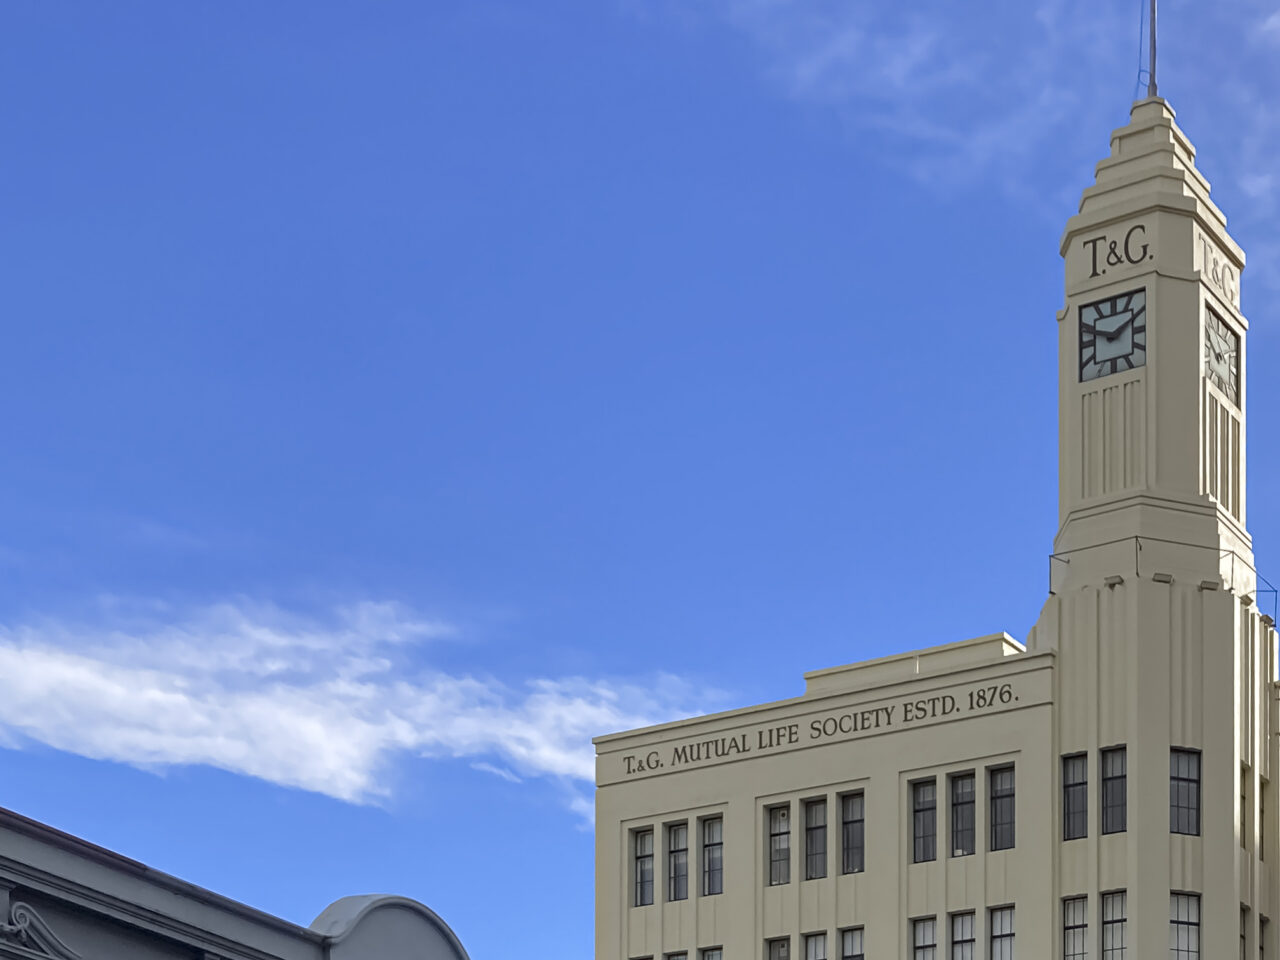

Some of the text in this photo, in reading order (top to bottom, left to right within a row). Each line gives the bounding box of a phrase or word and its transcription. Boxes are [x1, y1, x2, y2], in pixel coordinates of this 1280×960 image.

[671, 734, 752, 767] MUTUAL
[758, 724, 800, 750] LIFE
[809, 706, 896, 740] SOCIETY
[903, 695, 961, 723] ESTD.
[968, 683, 1020, 711] 1876.
